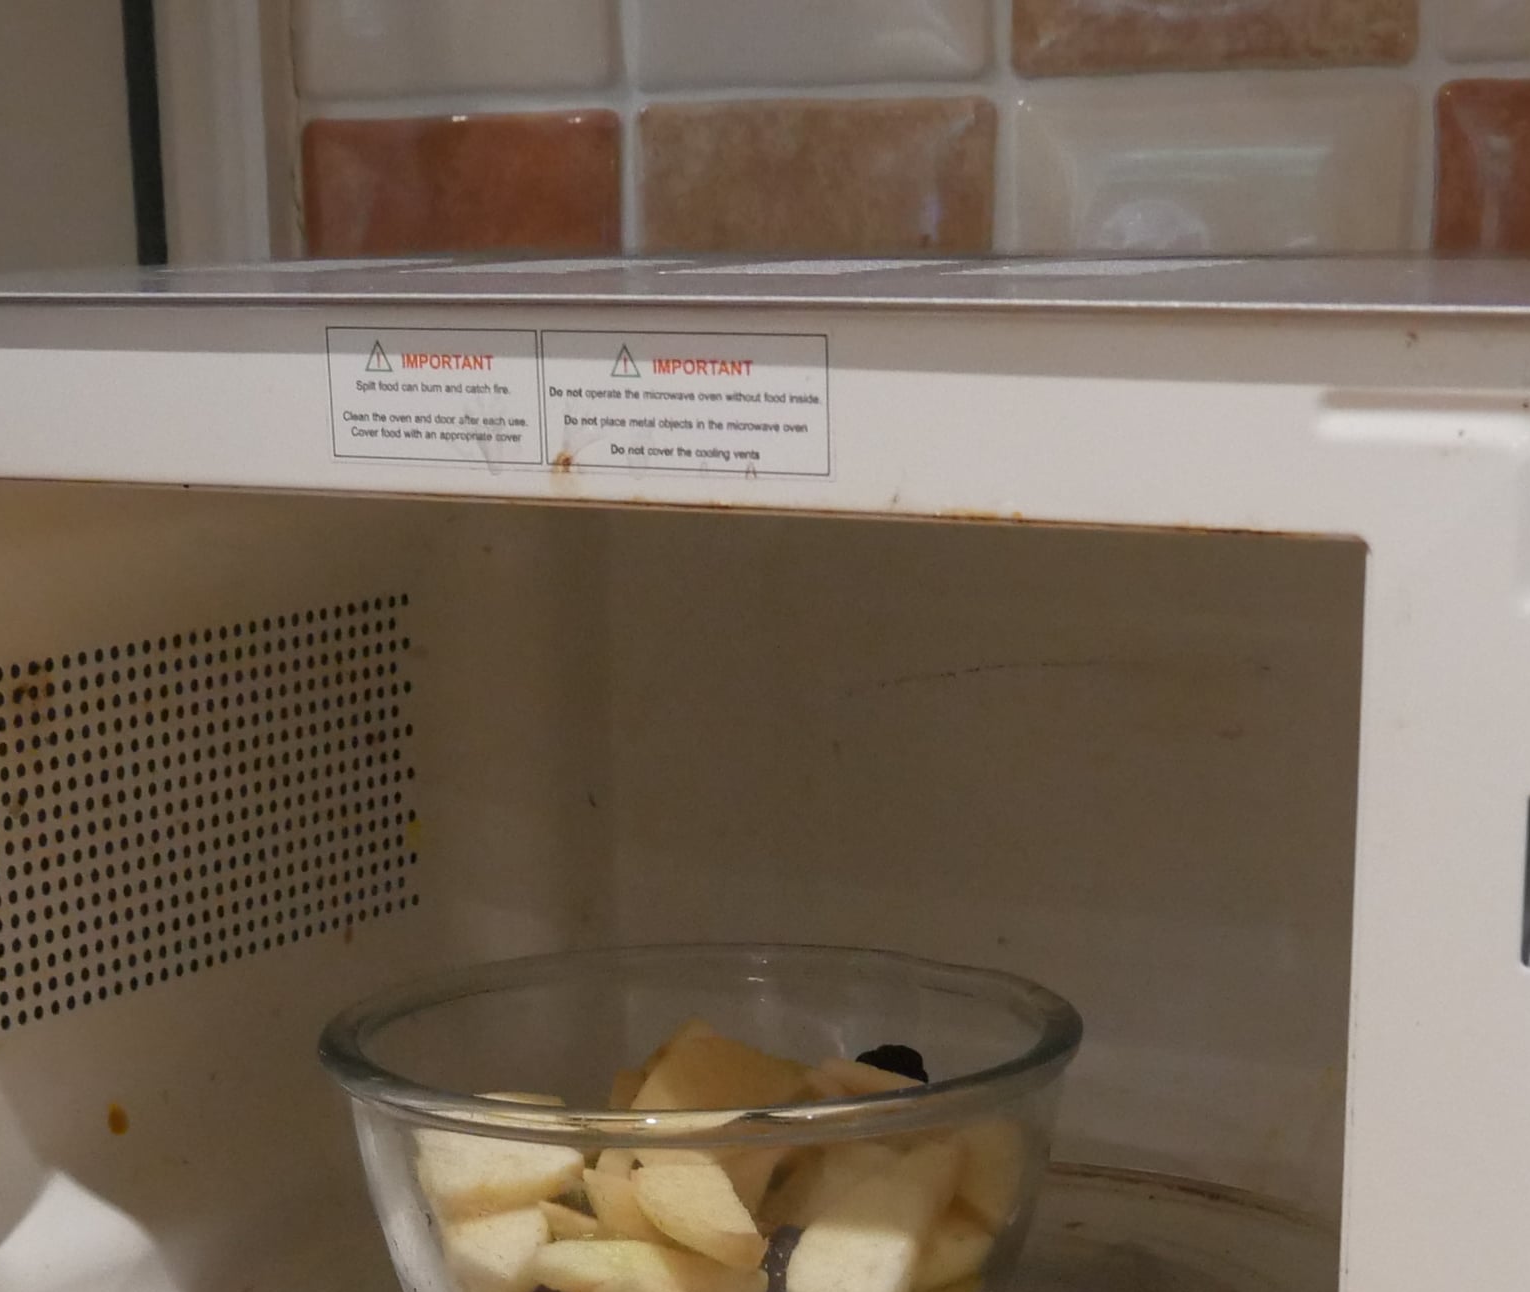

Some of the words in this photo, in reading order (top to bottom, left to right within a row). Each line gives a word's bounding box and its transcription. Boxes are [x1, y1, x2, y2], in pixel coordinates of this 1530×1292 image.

[402, 353, 494, 370] IMPORTANT
[653, 359, 753, 376] IMPORTANT
[379, 381, 399, 392] food
[401, 384, 418, 392] can
[445, 383, 462, 393] and
[466, 384, 490, 394] catch
[549, 387, 563, 398] Do
[566, 388, 582, 398] not
[585, 389, 622, 401] operate
[625, 389, 640, 399] the
[643, 390, 695, 401] microwave
[698, 393, 722, 401] oven
[725, 392, 761, 403] without
[765, 393, 786, 403] food
[343, 410, 369, 422] Clean
[373, 411, 387, 422] the
[389, 415, 411, 423] oven
[415, 413, 432, 424] and
[434, 414, 455, 424] door
[459, 414, 479, 425] after
[483, 415, 505, 426] each
[564, 415, 578, 426] Do
[581, 417, 597, 426] not
[600, 417, 626, 429] place
[629, 418, 655, 428] metal
[659, 418, 693, 431] objects
[696, 420, 705, 430] in
[708, 420, 723, 431] the
[727, 421, 780, 432] microwave
[783, 424, 808, 433] oven
[351, 426, 378, 438] Cover
[381, 428, 401, 438] food
[404, 428, 422, 439] with
[425, 431, 437, 440] an
[440, 431, 492, 443] appropriate
[496, 433, 522, 443] cover
[611, 444, 625, 455] Do
[628, 446, 644, 456] not
[647, 447, 673, 456] cover
[677, 446, 692, 457] the
[695, 447, 730, 461] cooling
[734, 449, 760, 460] vents
